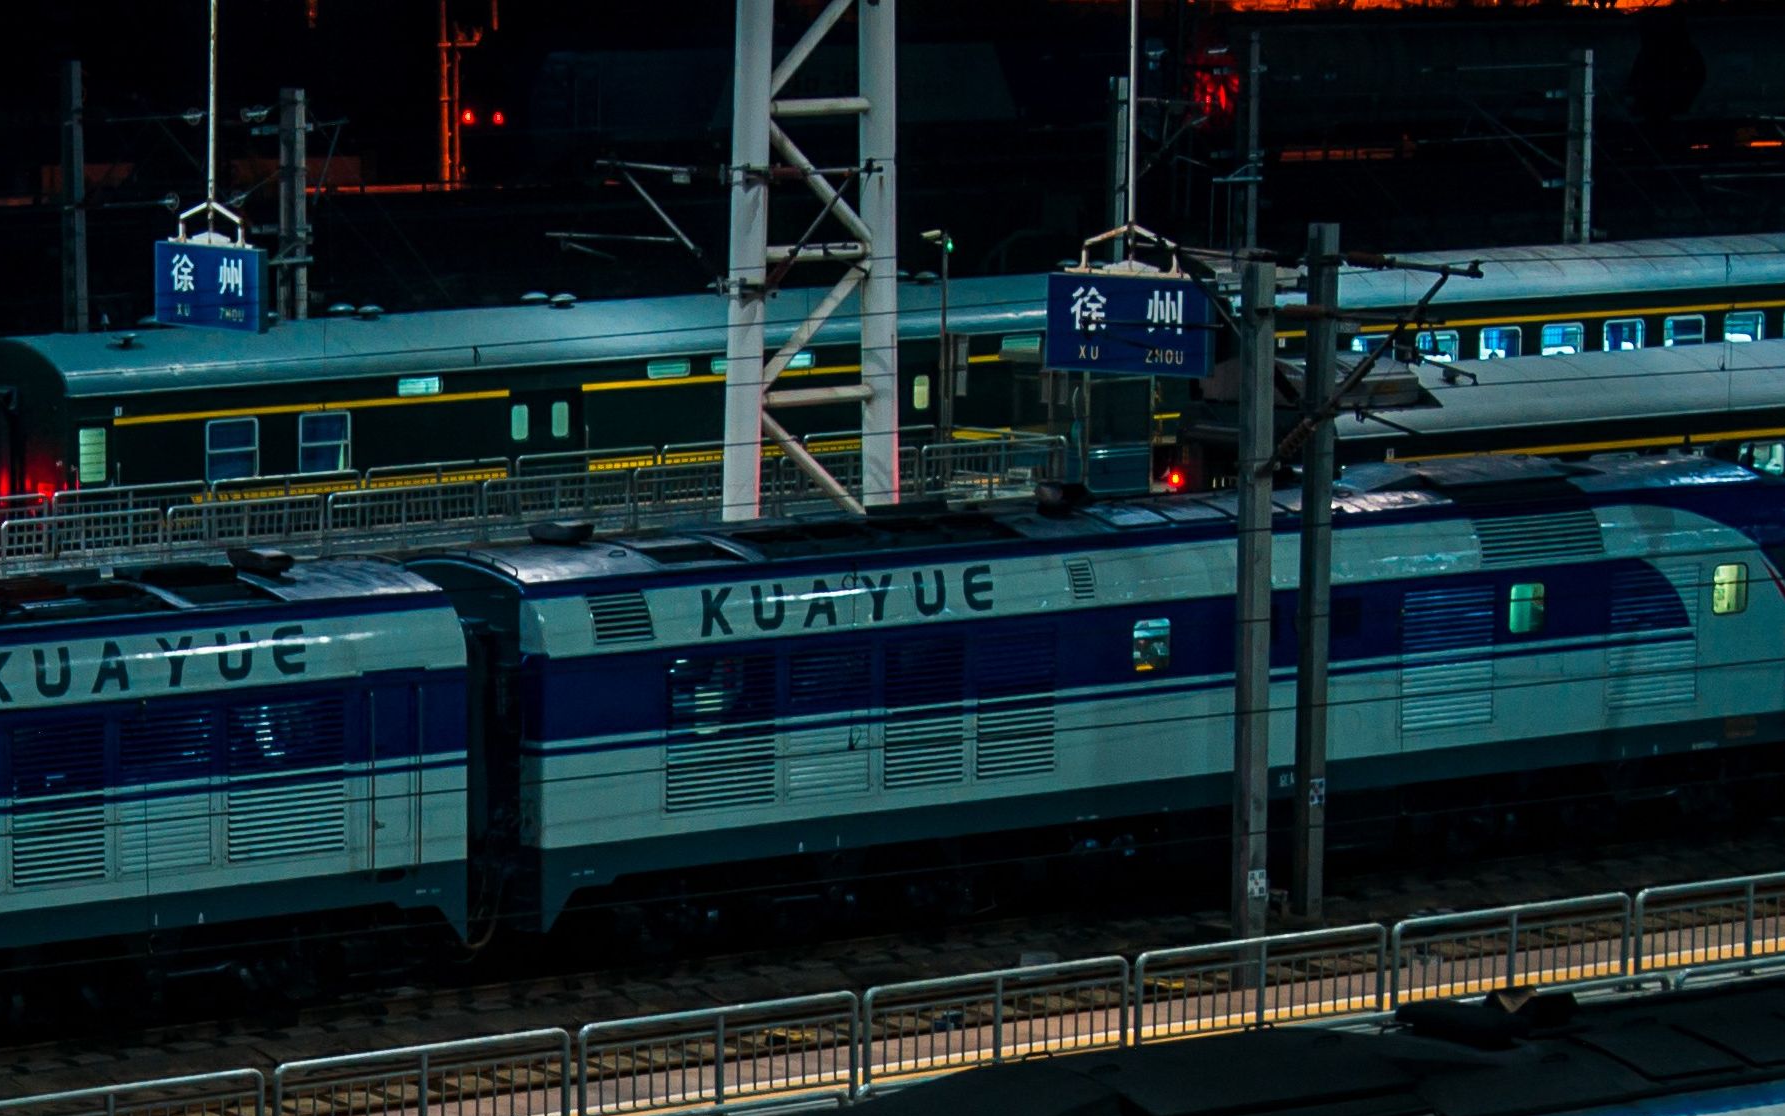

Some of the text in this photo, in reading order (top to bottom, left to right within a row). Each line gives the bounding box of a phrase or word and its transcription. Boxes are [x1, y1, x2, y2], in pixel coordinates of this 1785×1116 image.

[171, 254, 243, 297] 徐州
[176, 303, 191, 318] XU
[1070, 286, 1184, 335] 徐州
[1078, 345, 1185, 365] XU ZHOU
[700, 564, 994, 638] KUAYUE
